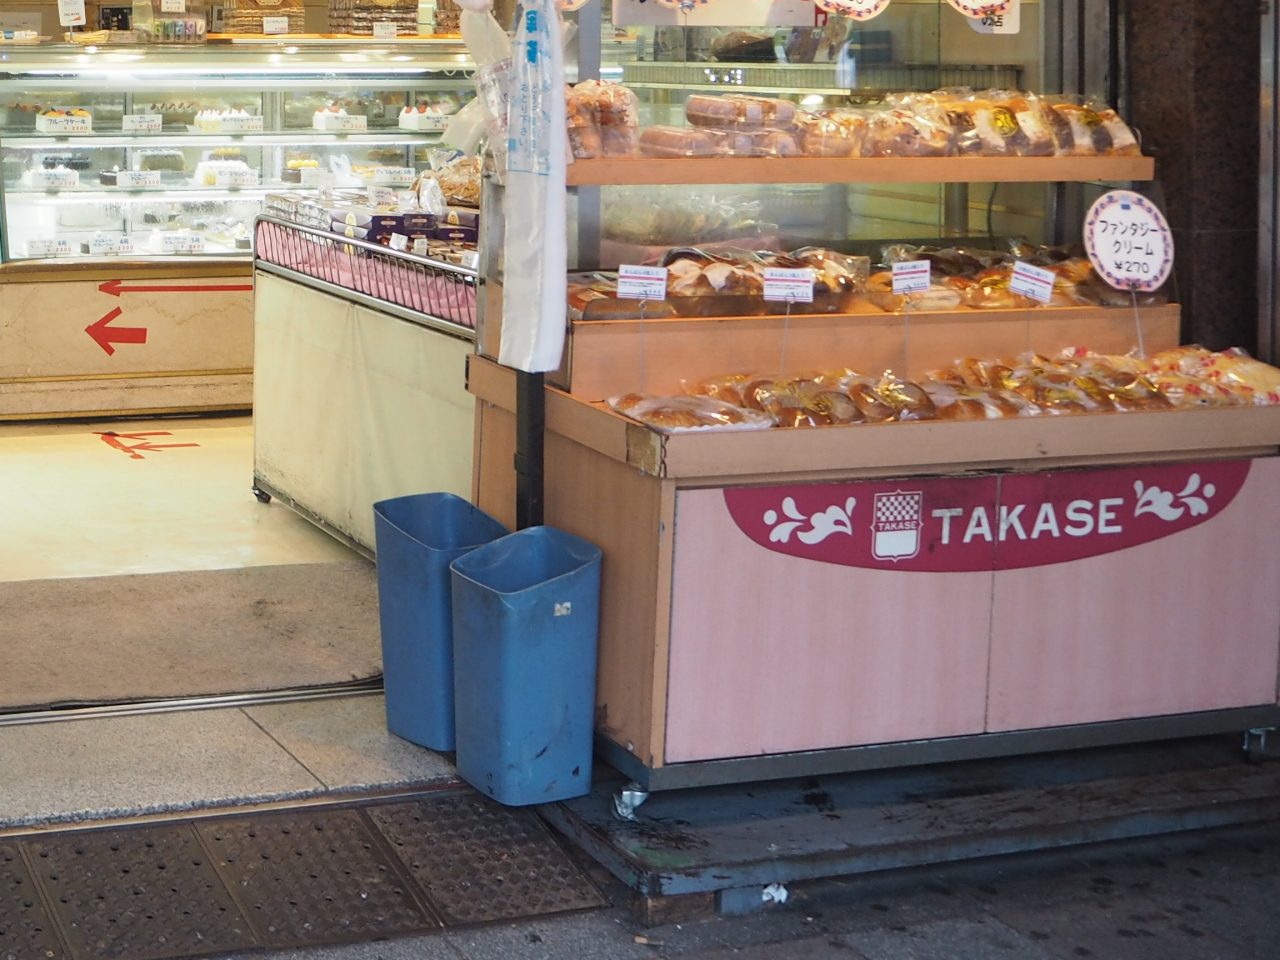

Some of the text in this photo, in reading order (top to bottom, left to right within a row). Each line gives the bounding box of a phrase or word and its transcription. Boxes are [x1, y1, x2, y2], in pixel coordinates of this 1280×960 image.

[1099, 219, 1159, 237] ファンタジー
[1113, 240, 1154, 256] クリーム
[1113, 260, 1150, 274] ¥270
[877, 520, 918, 532] TAKASE
[931, 497, 1124, 545] TAKASE
